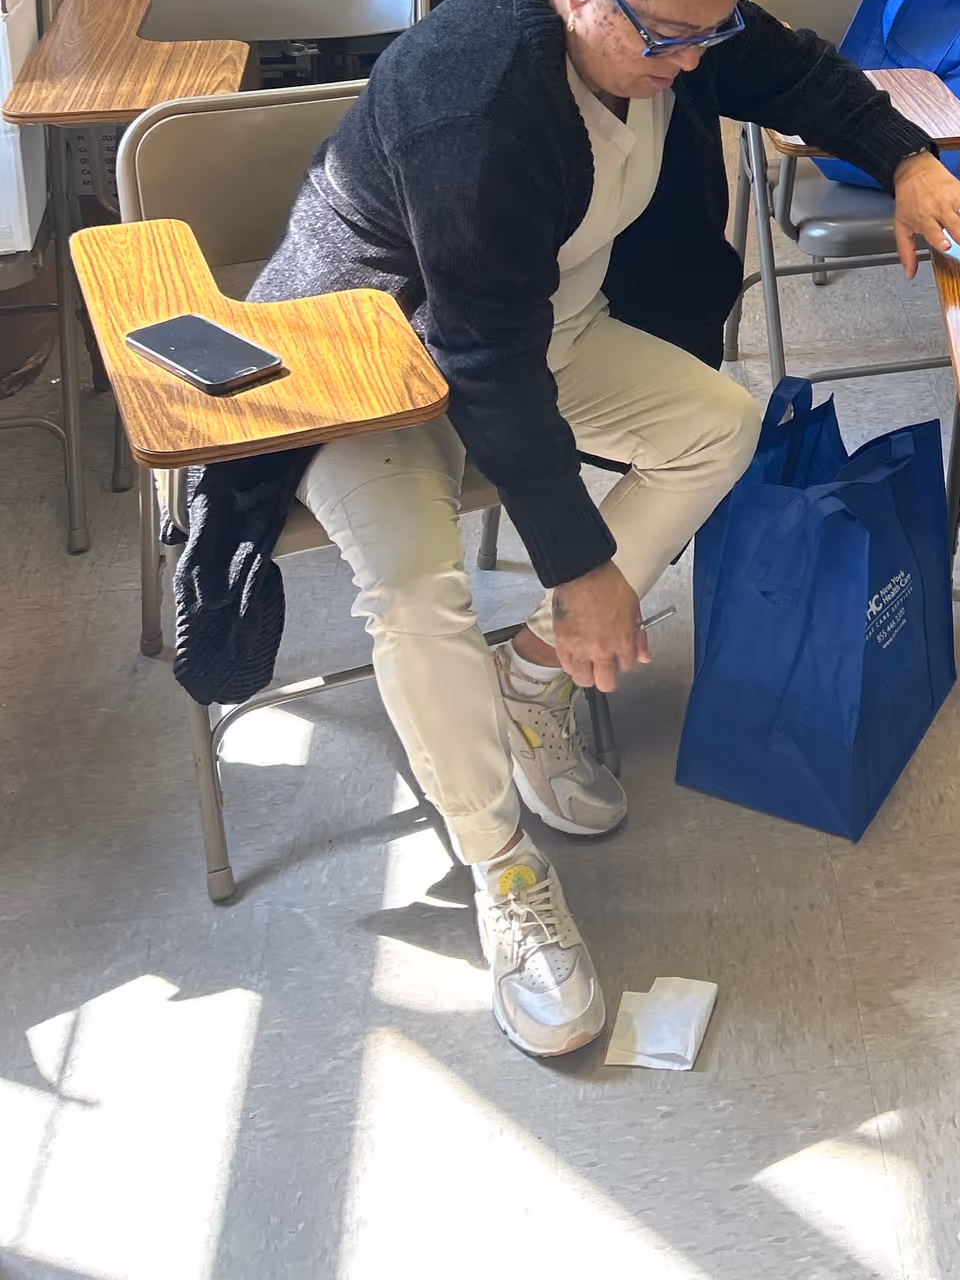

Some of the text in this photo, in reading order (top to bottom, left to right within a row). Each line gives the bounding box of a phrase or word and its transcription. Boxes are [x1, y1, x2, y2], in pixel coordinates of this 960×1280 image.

[879, 570, 906, 597] New York
[881, 573, 911, 604] Health Care
[875, 611, 890, 628] CARE
